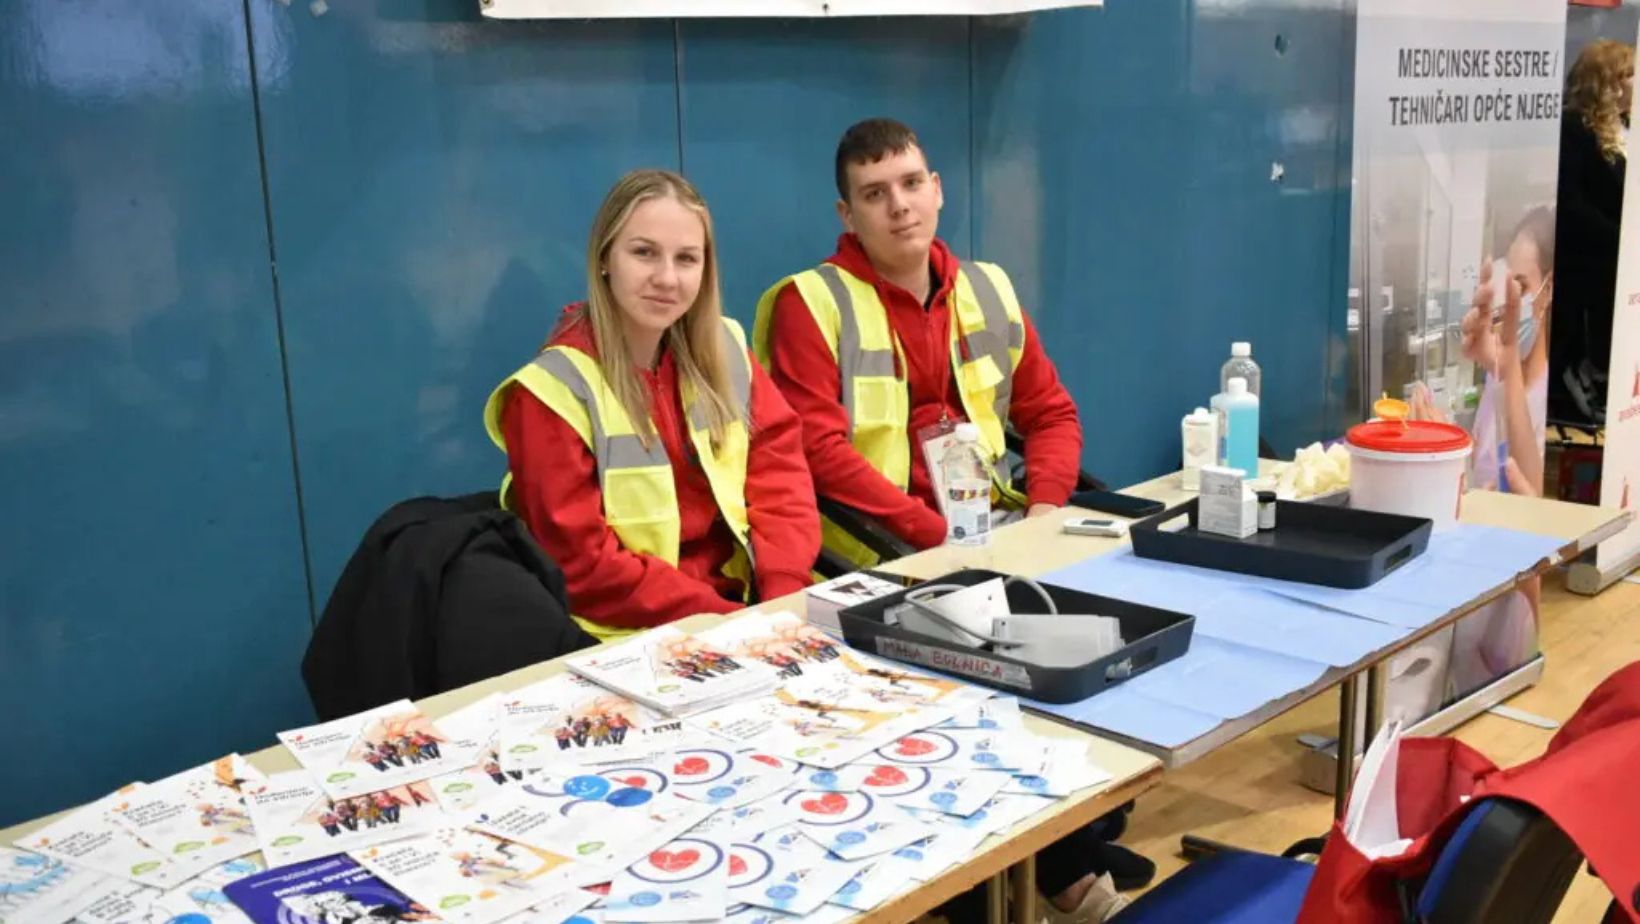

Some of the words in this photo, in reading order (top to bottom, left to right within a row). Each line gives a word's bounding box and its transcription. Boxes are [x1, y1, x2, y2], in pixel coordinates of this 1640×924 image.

[1398, 48, 1490, 79] MEDICINSKE
[1494, 50, 1550, 79] SESTRE
[1388, 89, 1469, 126] TEHNIČARI
[1473, 87, 1512, 123] OPĆE
[1516, 93, 1559, 120] NJEGE
